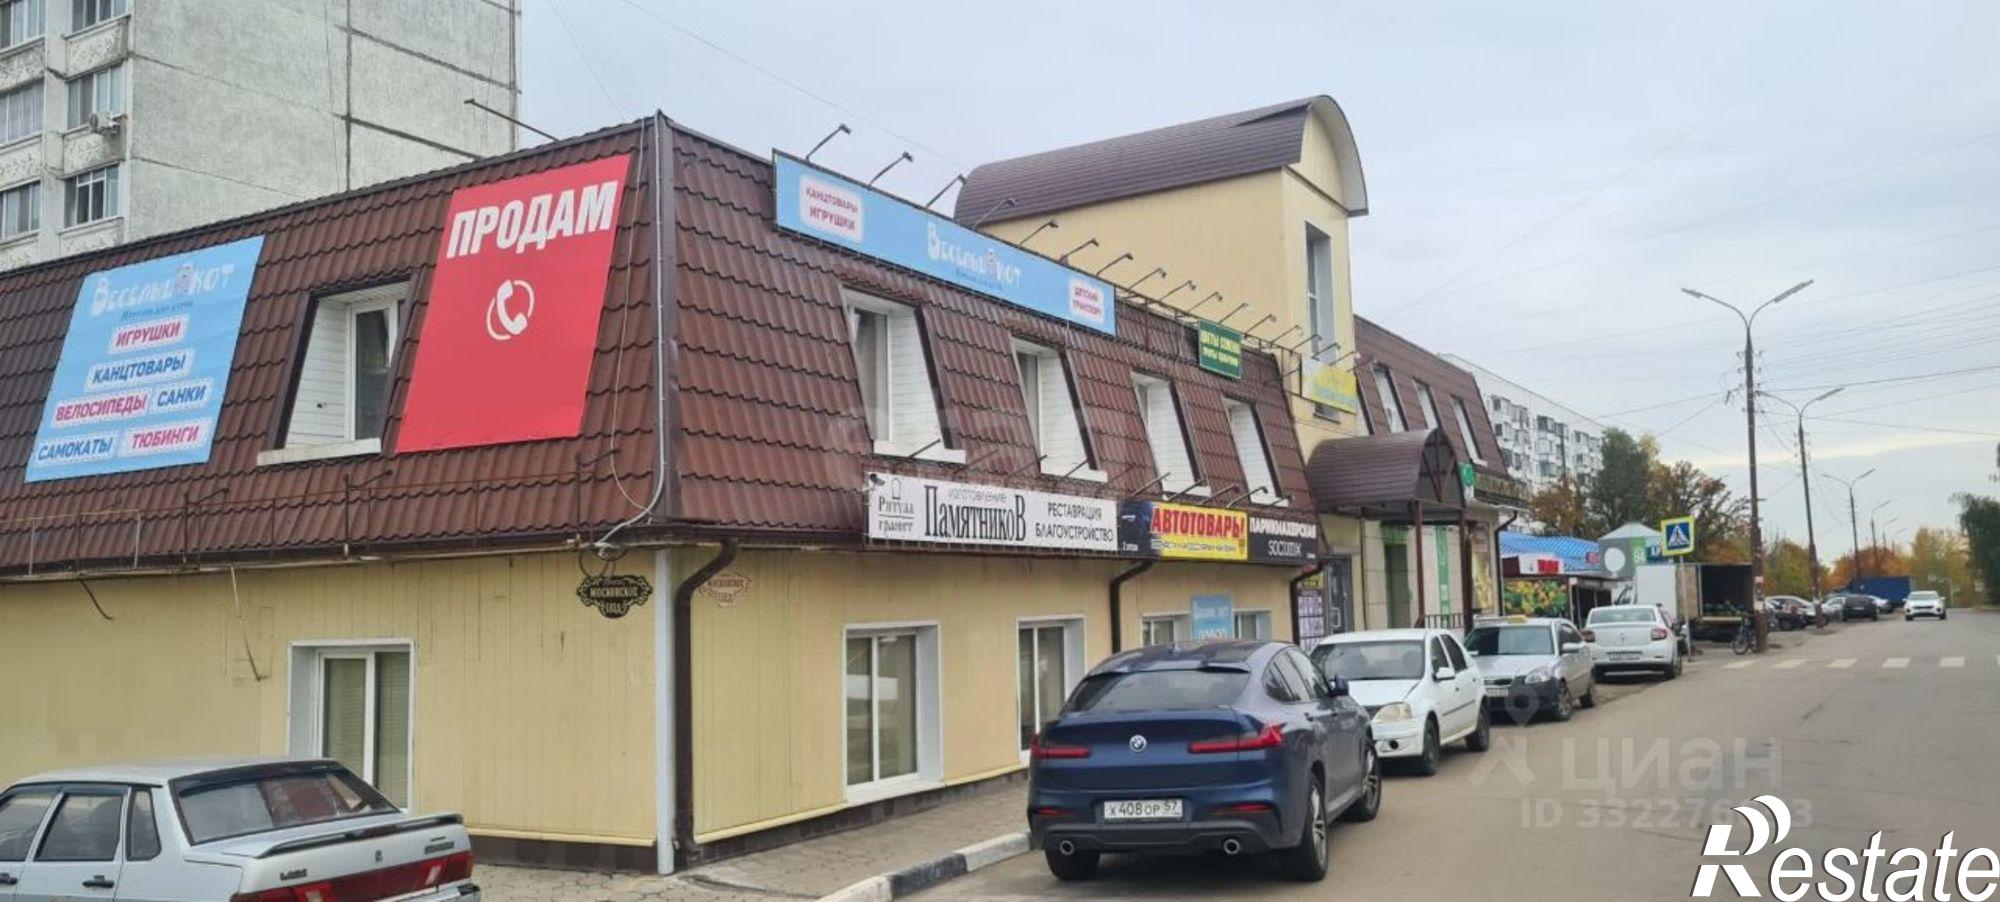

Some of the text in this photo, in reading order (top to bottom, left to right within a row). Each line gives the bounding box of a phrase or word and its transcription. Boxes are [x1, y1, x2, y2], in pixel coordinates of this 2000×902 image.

[446, 181, 618, 259] ПРОДАМ
[810, 205, 856, 231] ИГРУШКИ
[116, 320, 181, 346] ИГРУШКИ
[92, 355, 186, 384] КАНЦТОВАРЫ
[55, 384, 207, 422] ВЕЛОСИПЕДЫ САНКИ
[38, 425, 200, 461] САМОКАТЫ ТЮБИНГИ
[1048, 502, 1102, 520] РЕСТАВРАЦИЯ
[1035, 522, 1114, 542] БЛАГОУСТРОЙСТВО
